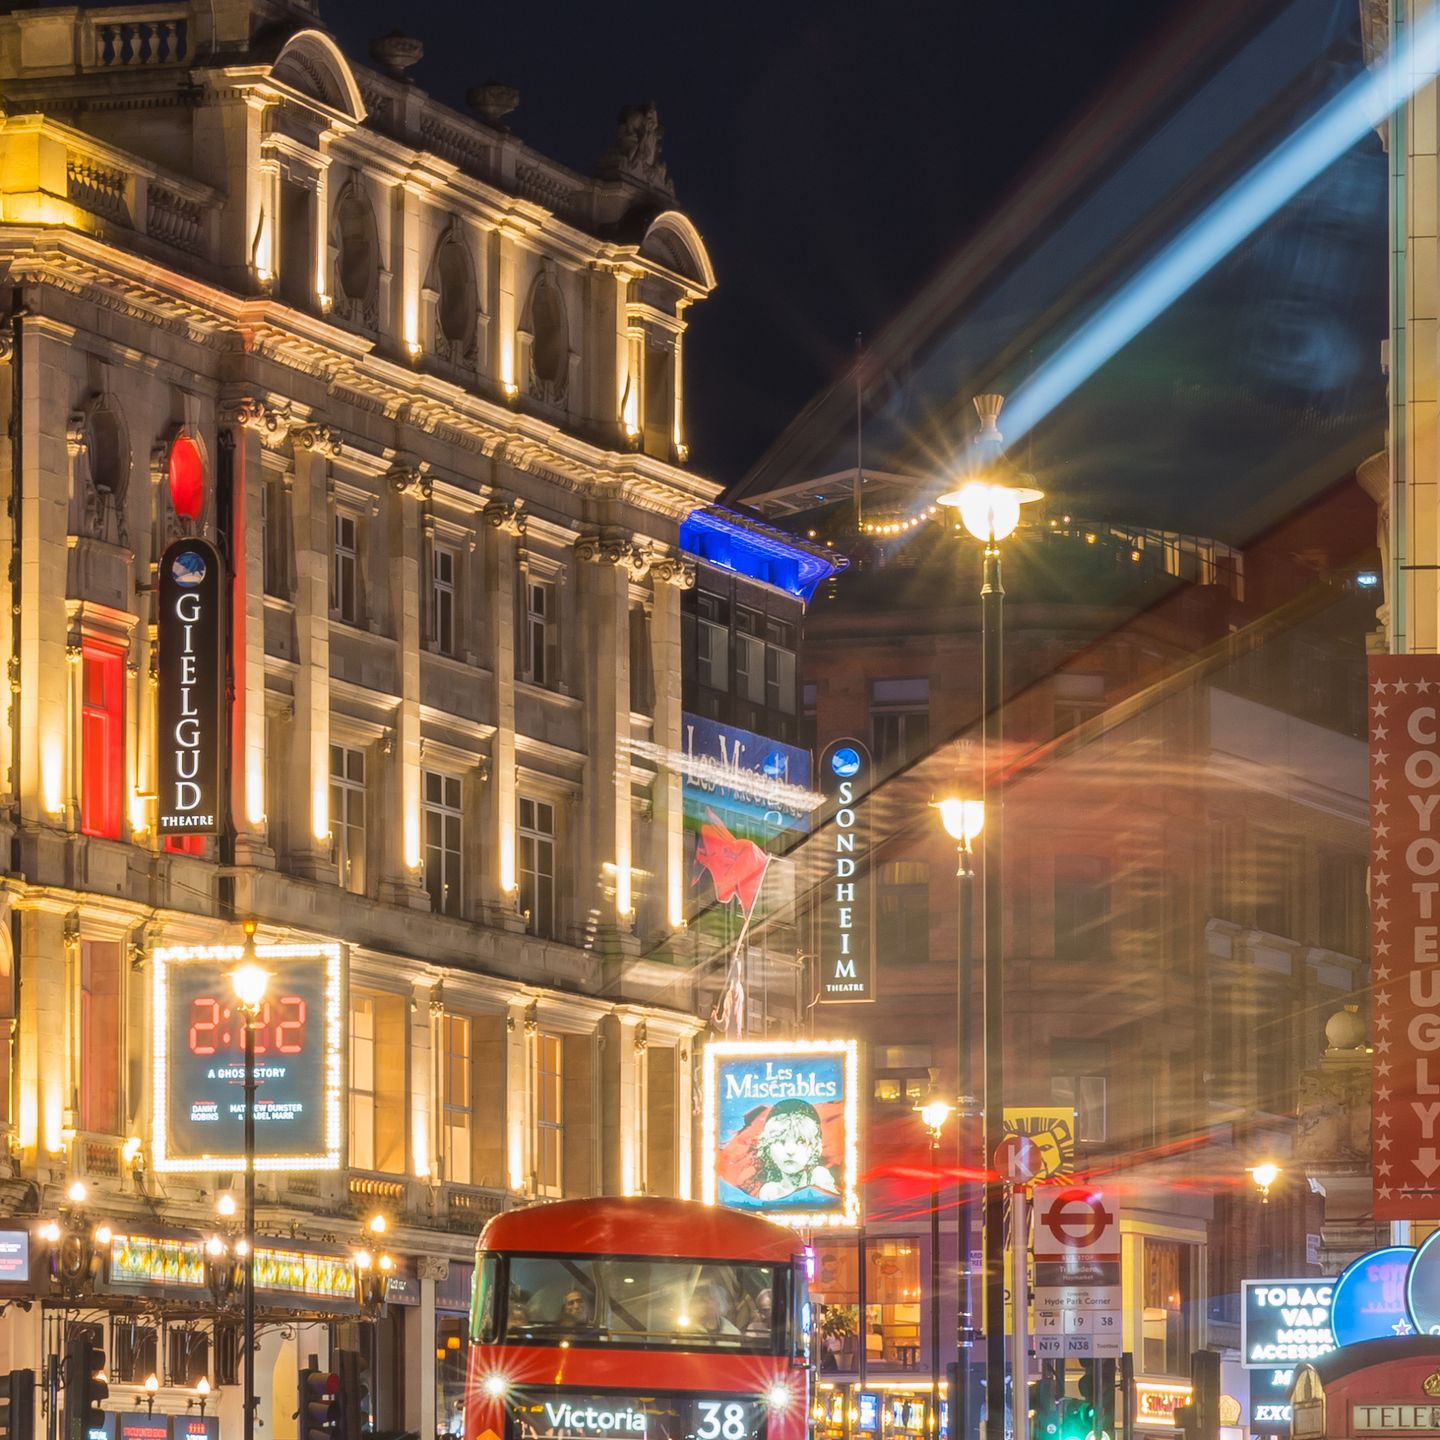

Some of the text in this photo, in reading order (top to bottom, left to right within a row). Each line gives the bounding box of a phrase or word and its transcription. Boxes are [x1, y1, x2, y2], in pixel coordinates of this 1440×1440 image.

[174, 592, 202, 811] GIELGUD
[160, 815, 215, 828] THEATRE
[834, 781, 857, 979] SONDHEIM
[826, 984, 864, 992] THEATRE
[208, 1068, 286, 1078] A GHOS STORY
[765, 1062, 793, 1081] Les
[725, 1072, 837, 1100] Misérables
[192, 1104, 218, 1112] DANNY
[230, 1104, 303, 1112] MATEW DUNSTER
[191, 1113, 219, 1121] ROBINS
[271, 1112, 294, 1120] MARR
[1008, 1145, 1034, 1178] K
[1044, 1298, 1065, 1307] Hyde
[1043, 1317, 1055, 1326] 14
[1073, 1317, 1084, 1326] 19
[1101, 1317, 1113, 1326] 38
[1039, 1342, 1060, 1351] N19
[1069, 1342, 1089, 1351] N38
[545, 1402, 746, 1440] Victoria 38
